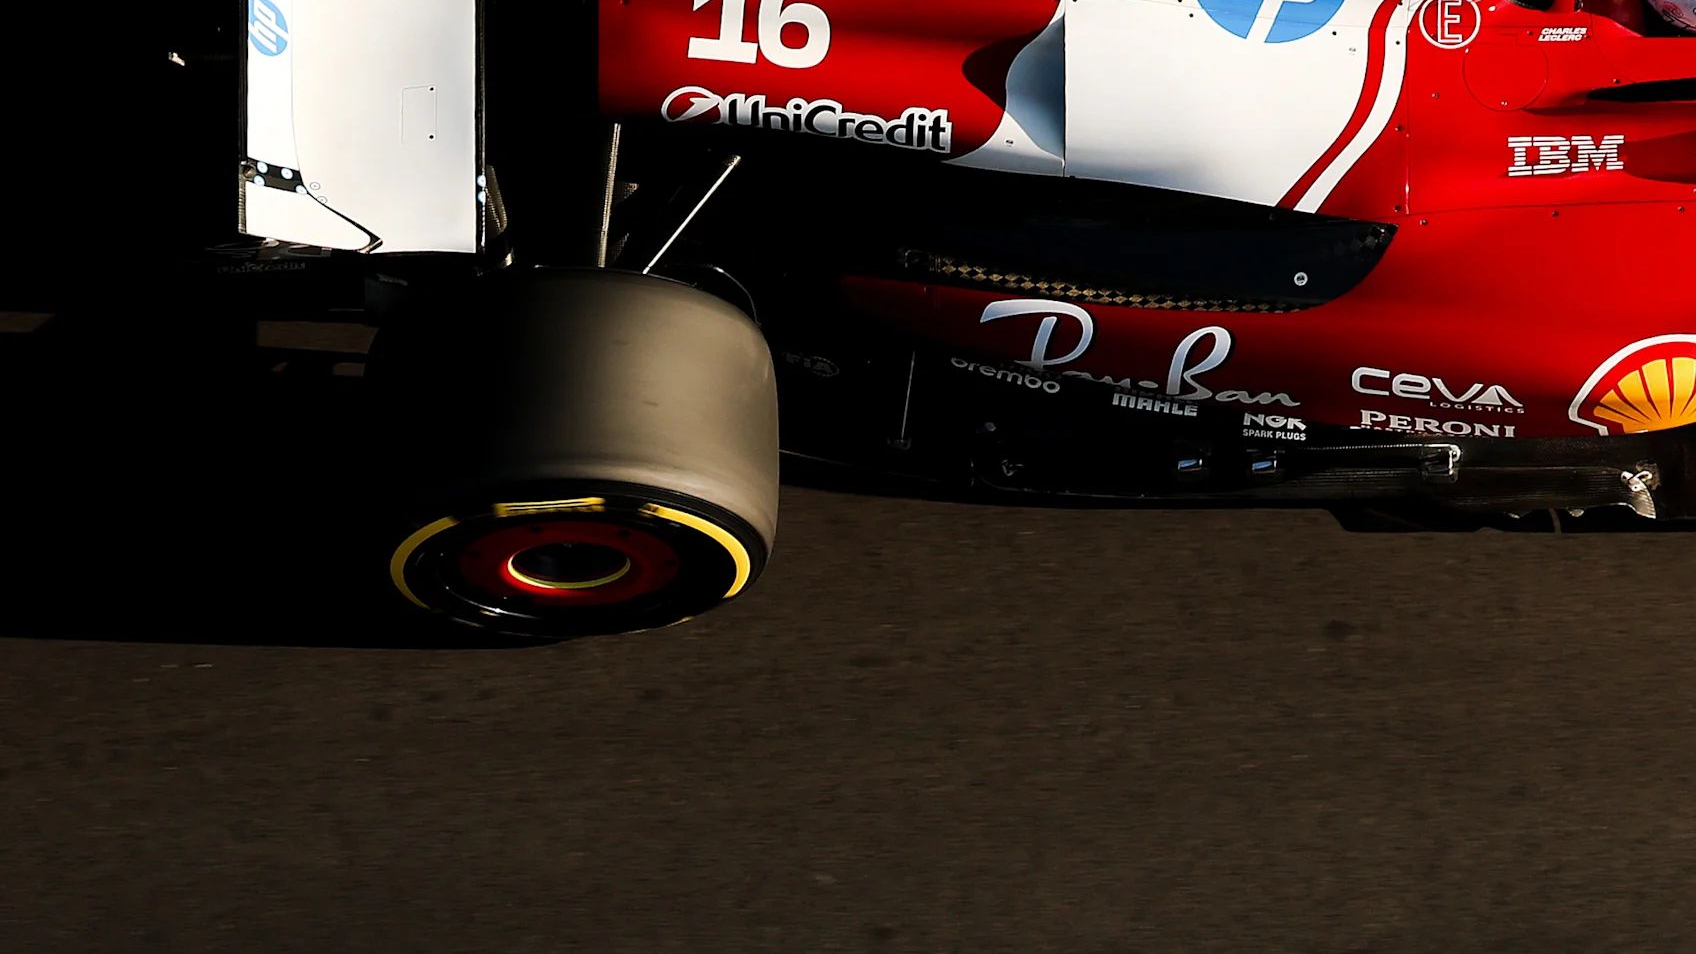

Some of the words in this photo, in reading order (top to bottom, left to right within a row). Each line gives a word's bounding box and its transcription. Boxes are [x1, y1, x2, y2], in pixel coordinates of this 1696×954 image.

[727, 93, 952, 153] UniCredit
[1507, 135, 1624, 177] IBM
[1112, 393, 1198, 416] MAHLE
[1429, 401, 1525, 413] LOGISTICS
[1243, 413, 1306, 430] NGK
[1360, 409, 1516, 438] PERONI
[1243, 429, 1274, 440] SPARK
[1275, 431, 1306, 441] PLUGS
